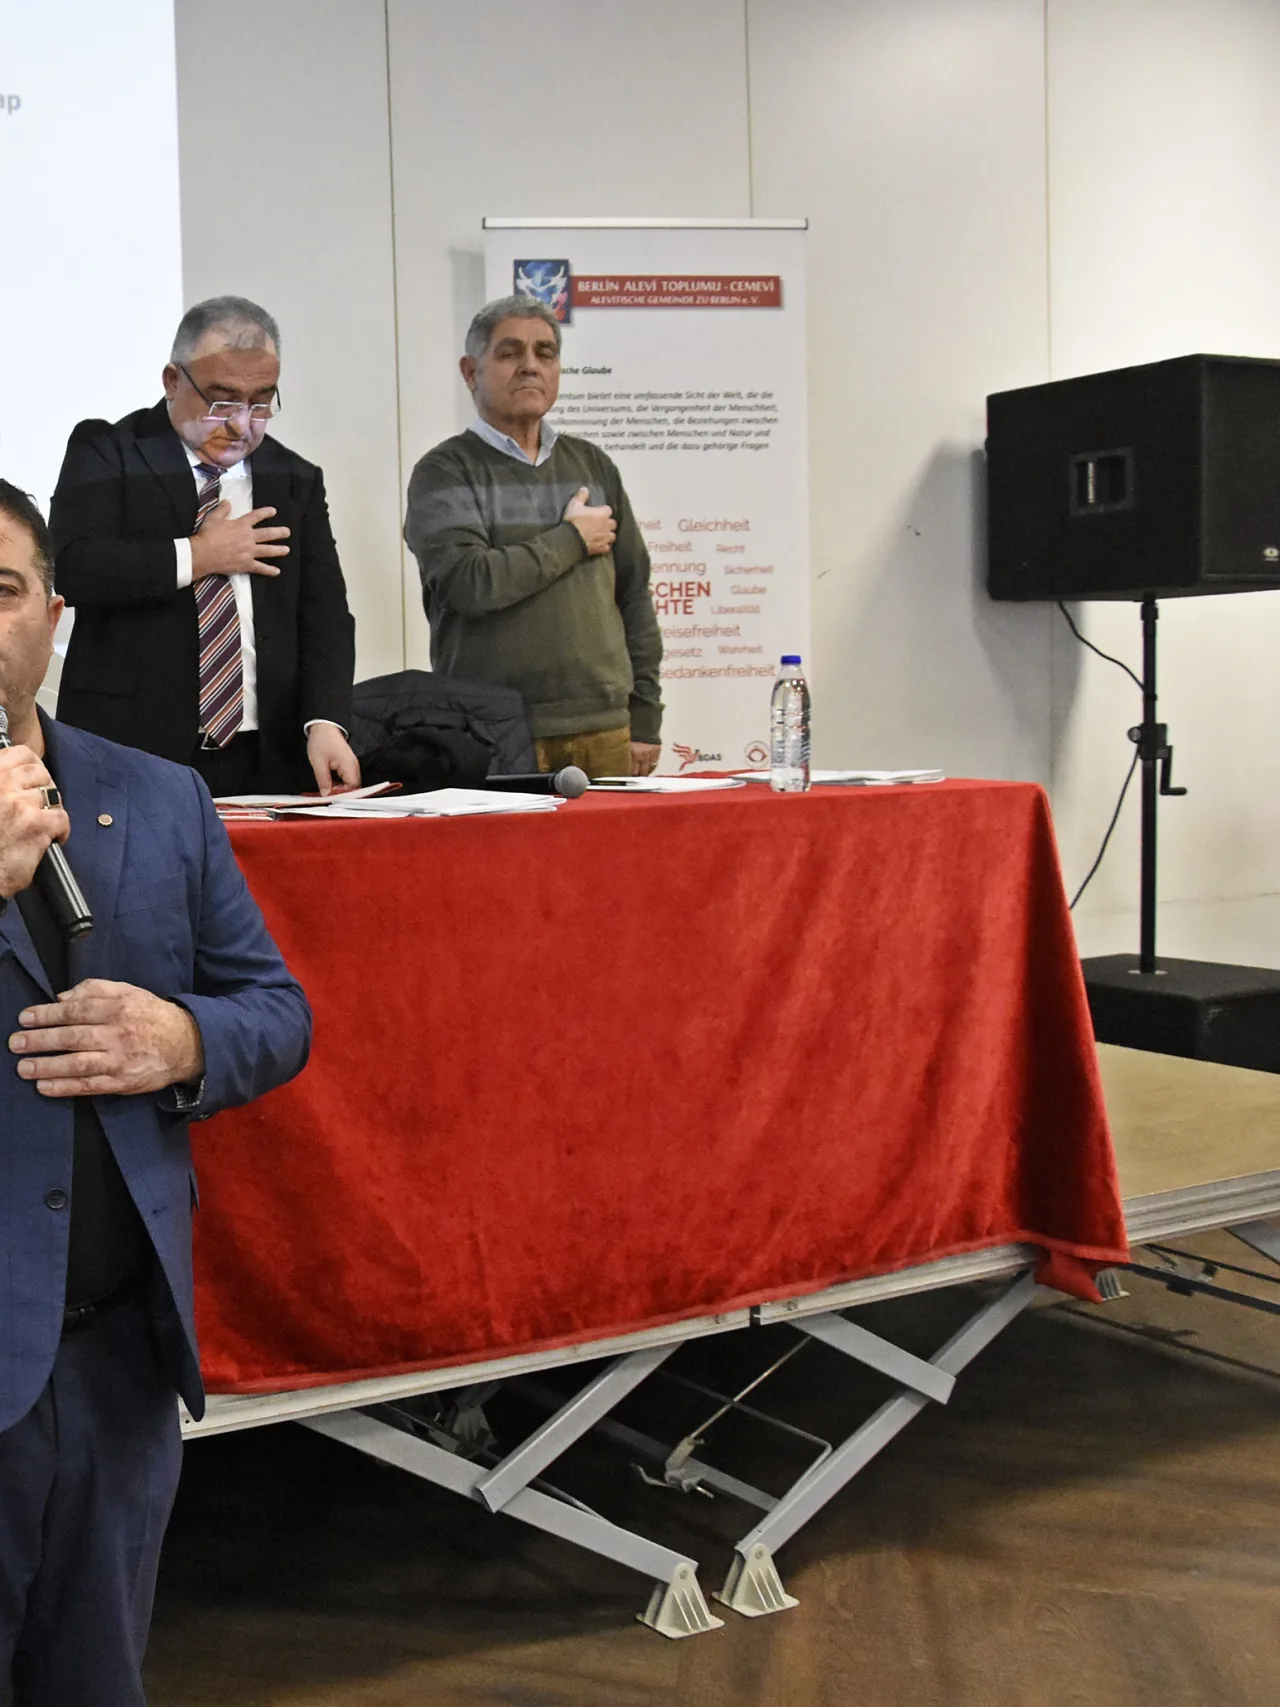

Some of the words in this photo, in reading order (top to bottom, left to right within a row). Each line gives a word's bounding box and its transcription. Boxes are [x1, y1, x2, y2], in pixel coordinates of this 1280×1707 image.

[662, 280, 722, 292] TOPLUMU
[648, 296, 694, 305] GEMEINDE
[696, 296, 709, 304] ZU
[710, 296, 741, 304] BERLIN
[582, 366, 612, 374] Glaube
[678, 518, 750, 532] Gleichheit
[647, 541, 692, 552] Freiheit
[651, 562, 706, 575] ennung
[724, 564, 774, 575] Sicherheit
[663, 624, 740, 638] eisefreiheit
[663, 646, 702, 660] gesetz
